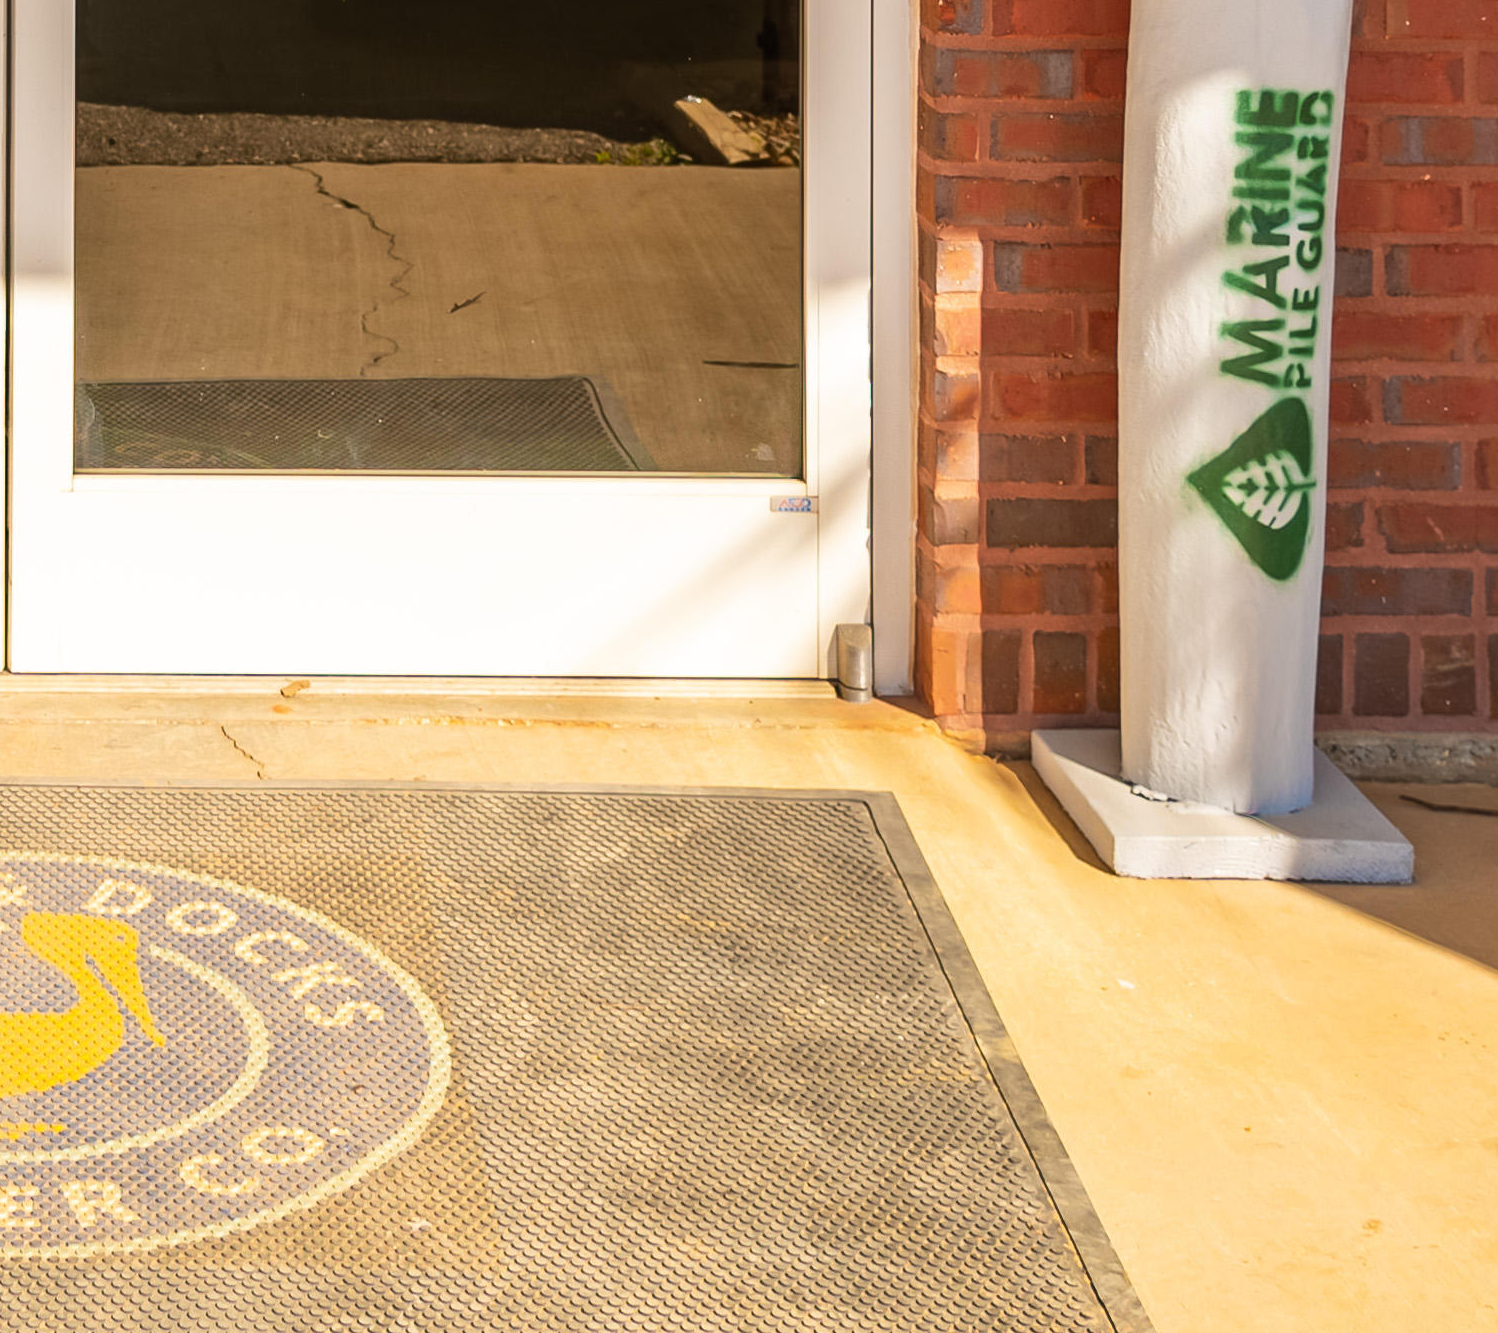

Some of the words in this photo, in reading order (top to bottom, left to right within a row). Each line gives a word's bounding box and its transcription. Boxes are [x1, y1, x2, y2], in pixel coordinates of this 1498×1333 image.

[1219, 88, 1300, 389] MARINE
[1294, 89, 1335, 272] GUARD
[1283, 284, 1320, 389] PILE
[82, 878, 386, 1028] DOCKS
[178, 1125, 353, 1196] CO.
